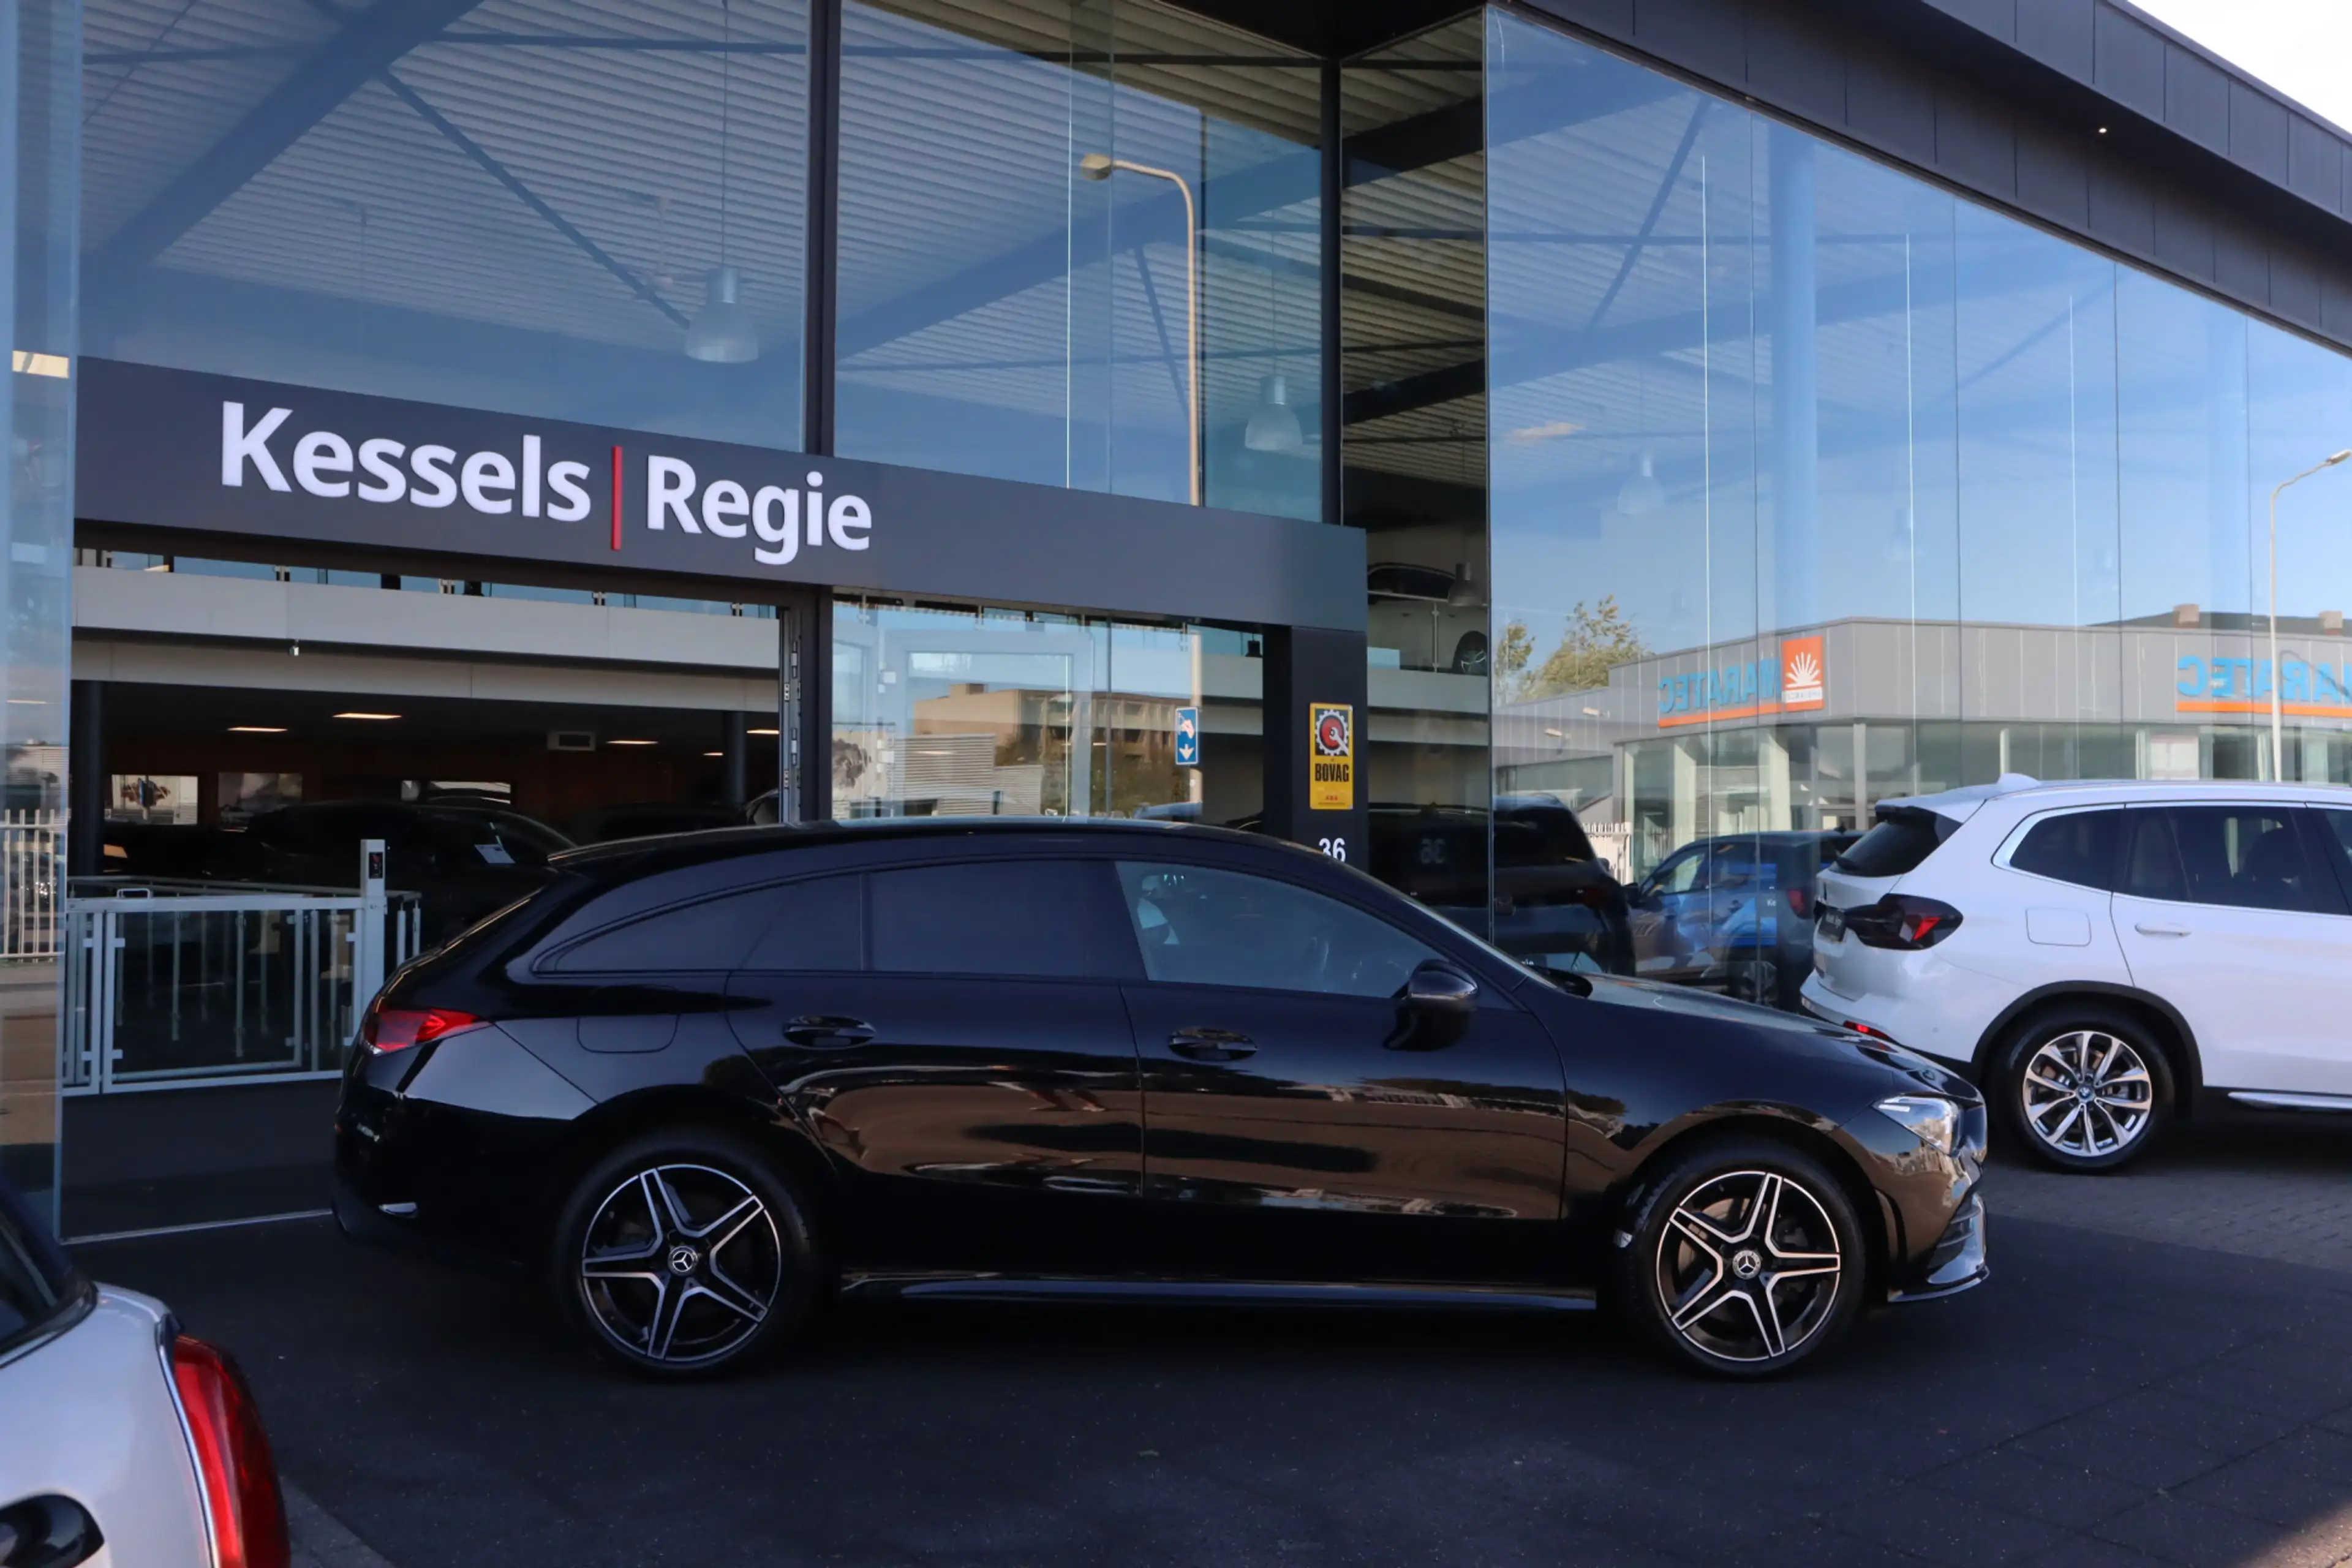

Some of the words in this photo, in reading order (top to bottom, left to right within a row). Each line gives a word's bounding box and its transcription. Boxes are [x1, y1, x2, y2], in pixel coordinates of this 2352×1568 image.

[222, 401, 591, 522] Kessels
[647, 454, 872, 565] Regie
[1314, 763, 1349, 782] BOVAG
[1319, 837, 1346, 862] 36
